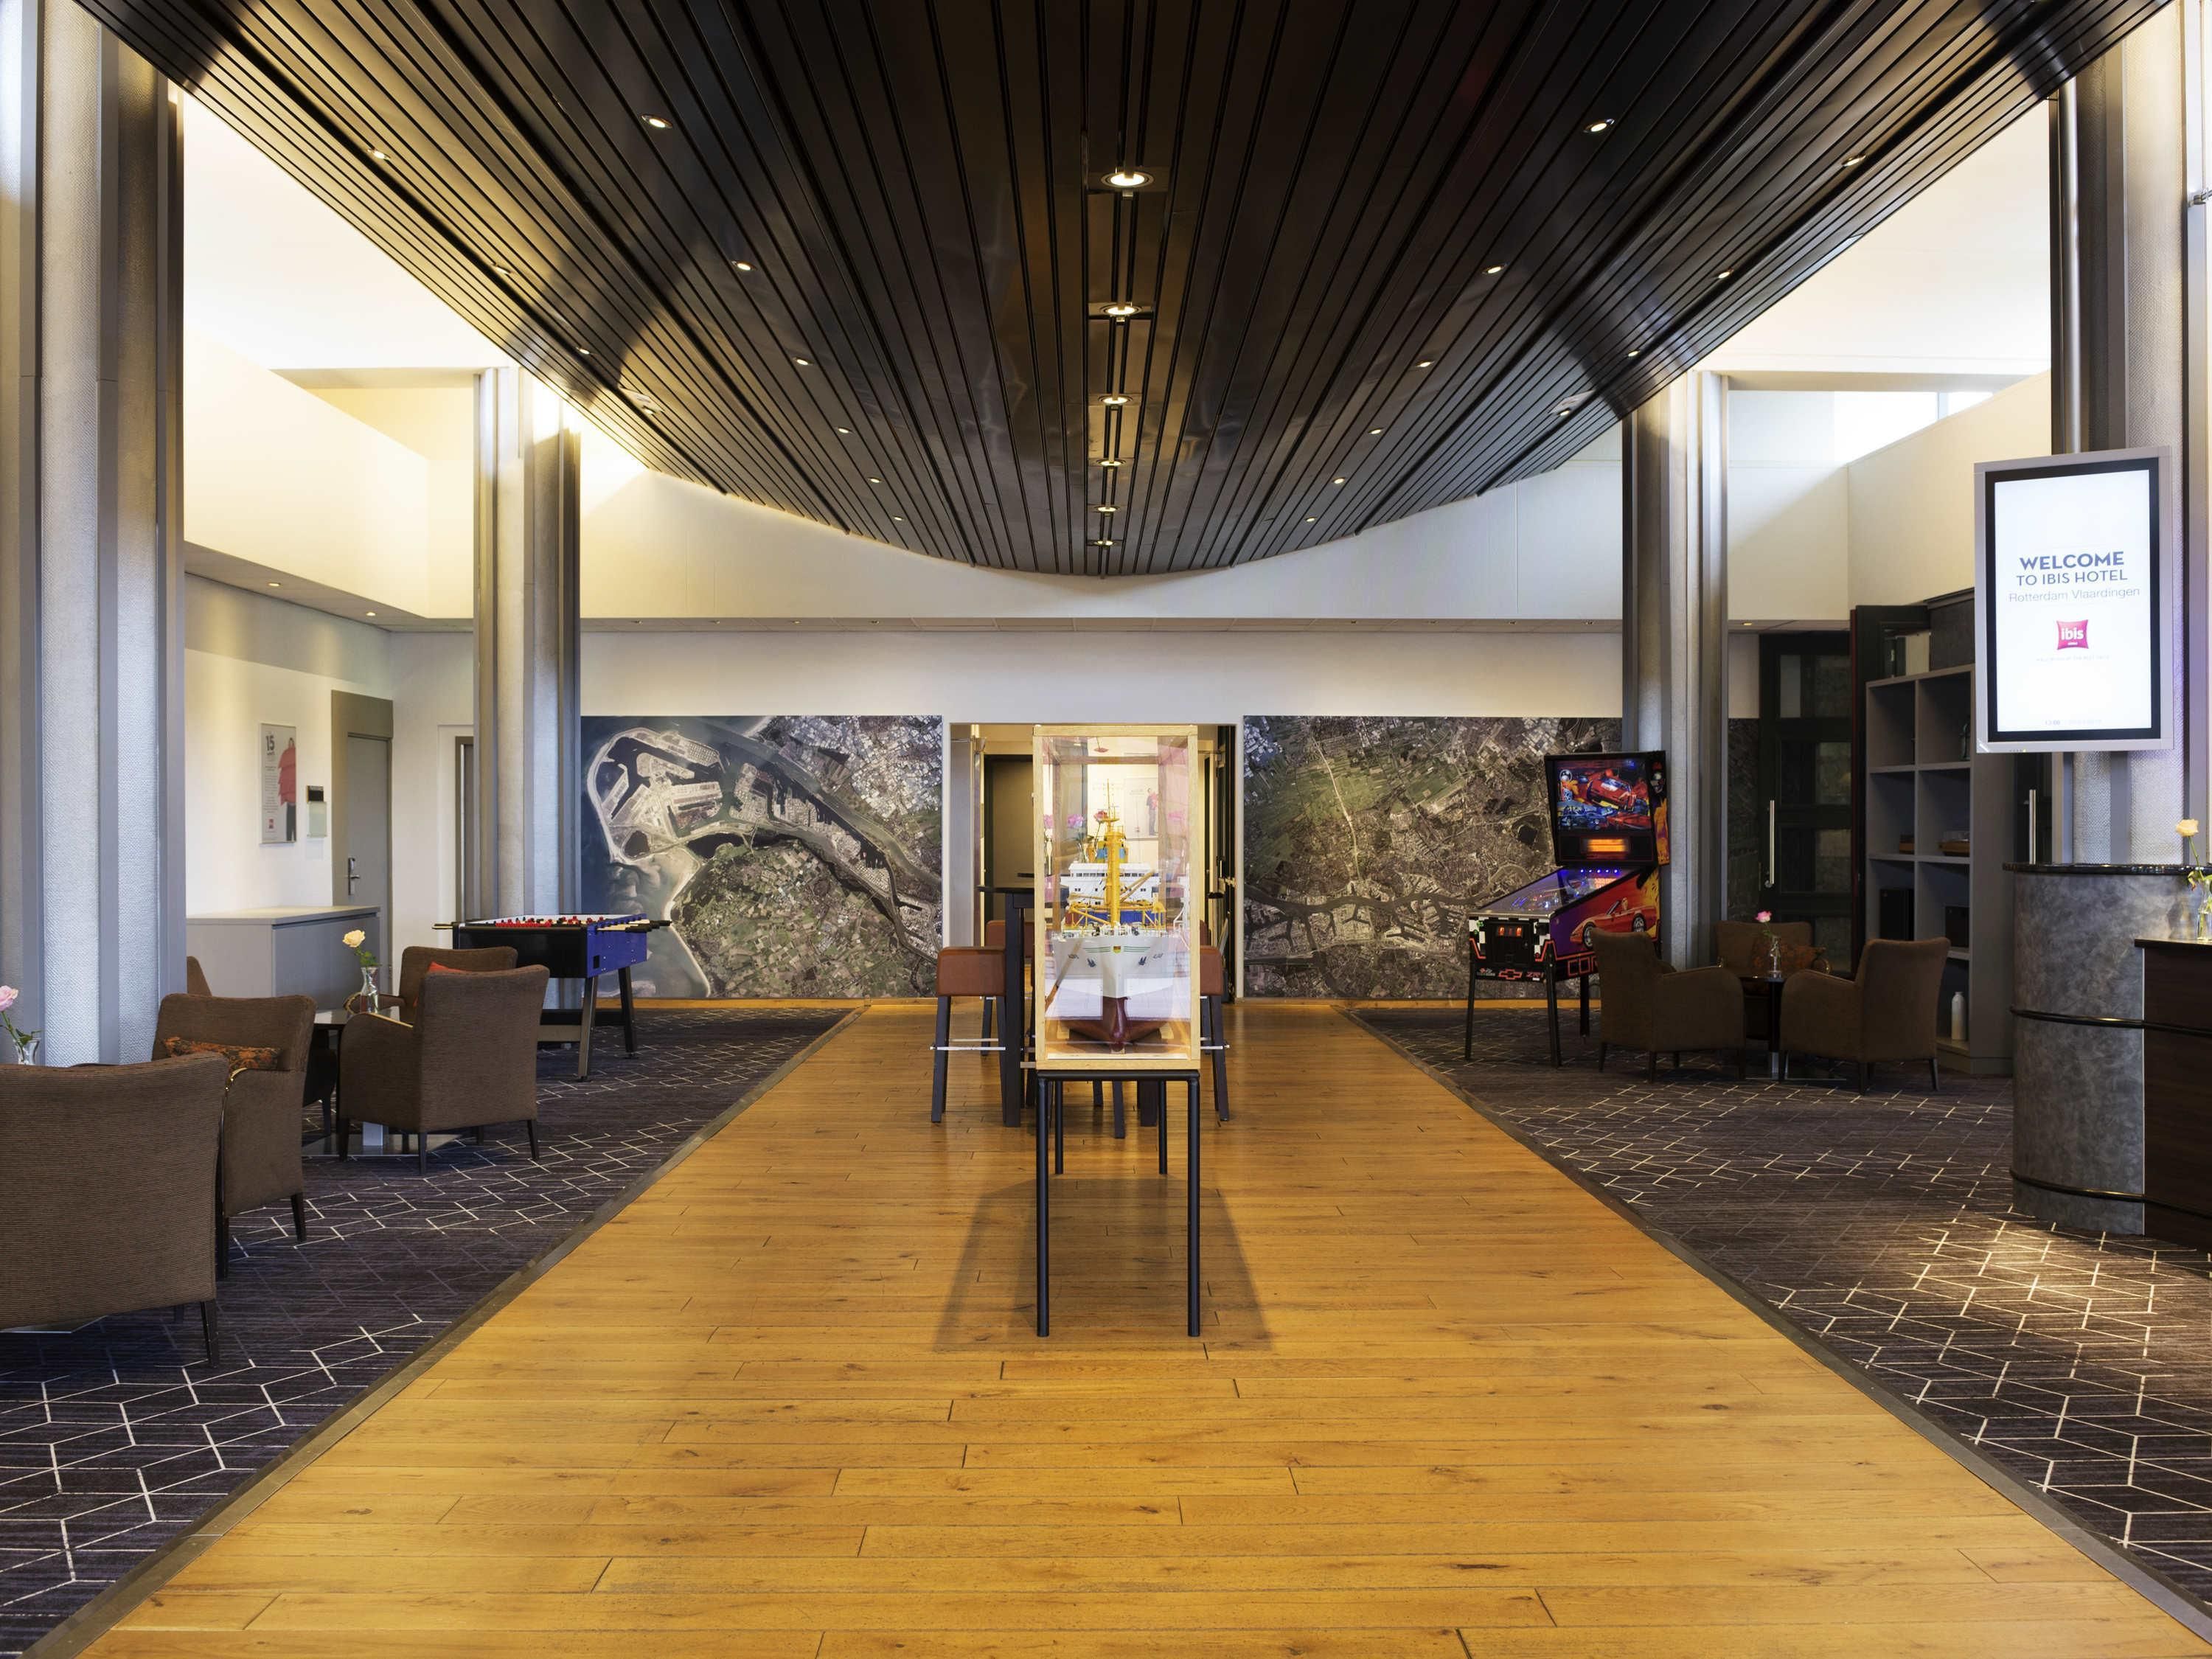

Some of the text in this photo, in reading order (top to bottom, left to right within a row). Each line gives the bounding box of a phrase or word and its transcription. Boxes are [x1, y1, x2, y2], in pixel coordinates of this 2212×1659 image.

[2019, 551, 2124, 571] WELCOME
[2017, 569, 2128, 586] TO IBIS HOTEL
[2009, 588, 2140, 602] Rotterdam Vlaardingen
[2061, 627, 2084, 641] ibis
[265, 735, 275, 751] 15
